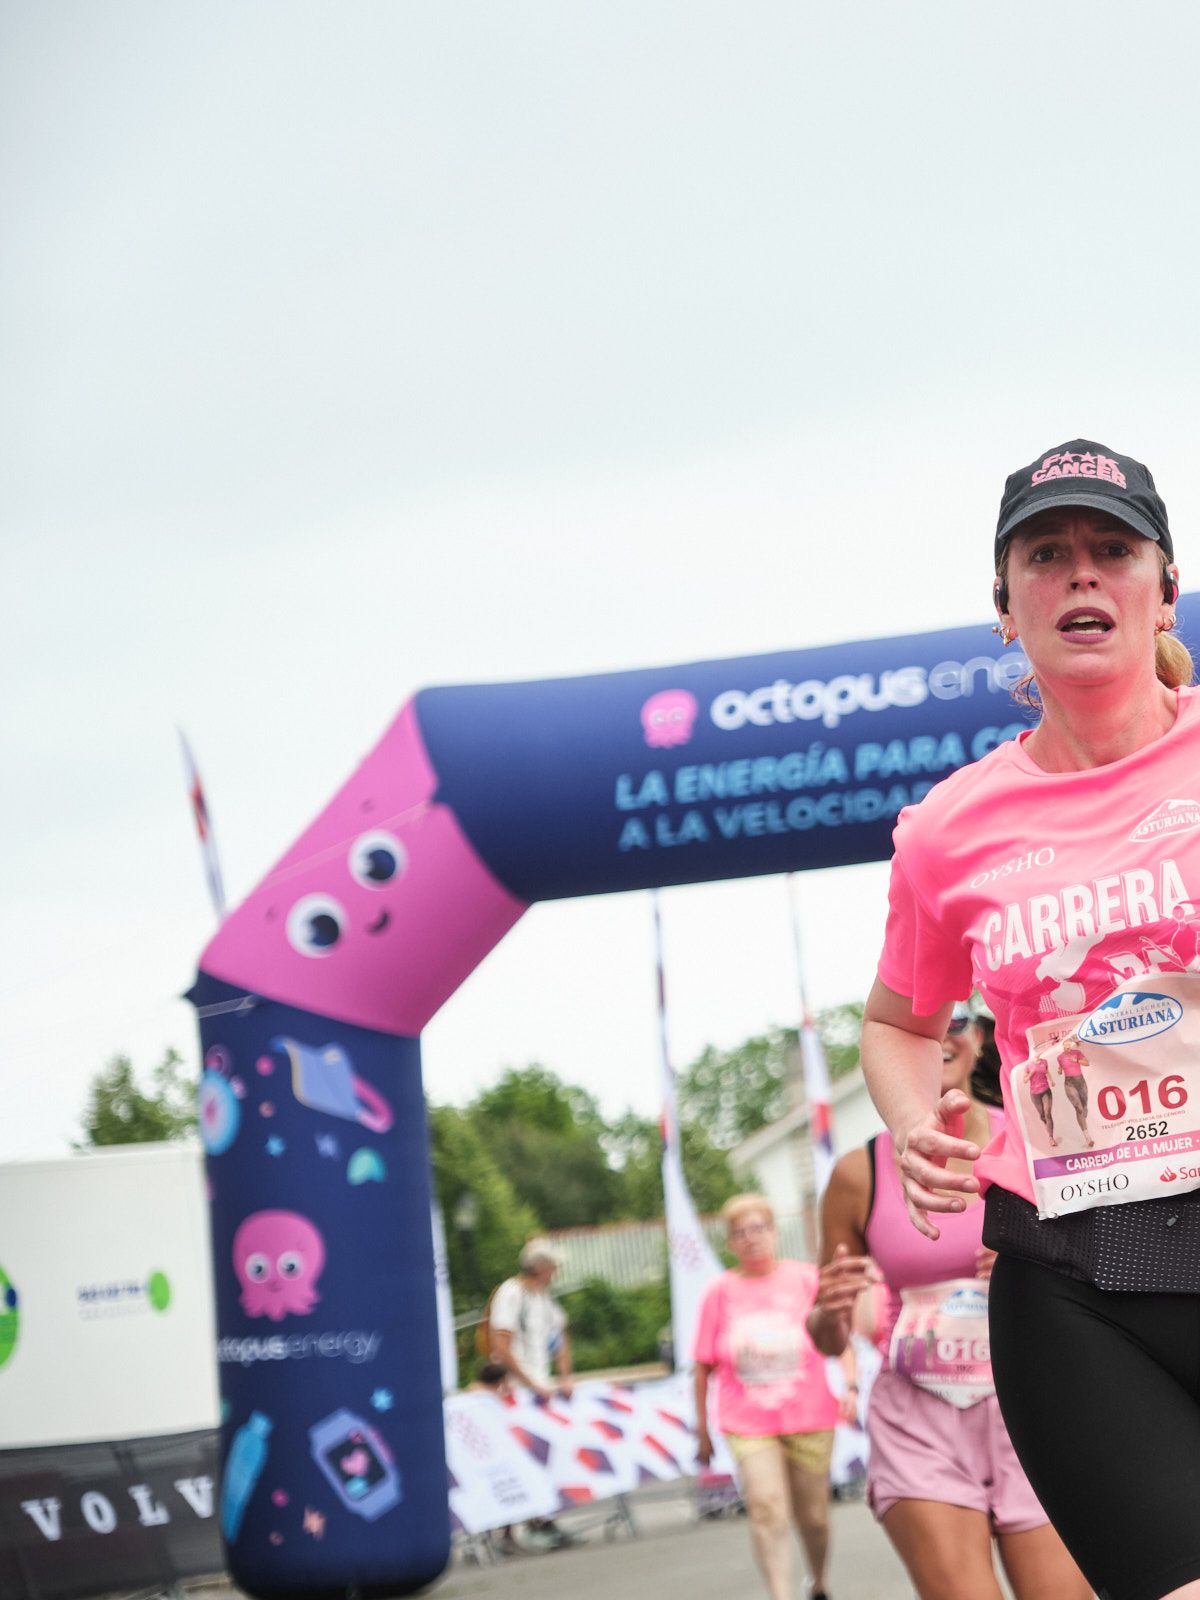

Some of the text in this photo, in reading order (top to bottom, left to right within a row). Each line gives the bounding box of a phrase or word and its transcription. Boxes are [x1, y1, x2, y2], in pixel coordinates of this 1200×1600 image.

[1031, 462, 1127, 486] CANCER
[615, 769, 669, 811] LA
[673, 740, 849, 804] ENERGÍA
[854, 731, 965, 780] PARA
[618, 816, 650, 852] A
[655, 809, 711, 847] LA
[970, 848, 1055, 888] OYSHO
[984, 859, 1195, 972] CARRERA
[1084, 1007, 1175, 1037] ASTURIANA
[1097, 1075, 1188, 1121] 016
[1125, 1120, 1169, 1141] 2652
[1066, 1152, 1114, 1171] CARRERA
[1116, 1145, 1132, 1160] DE
[1134, 1143, 1151, 1158] LA
[1153, 1136, 1194, 1154] MUJER
[1060, 1173, 1129, 1202] OYSHO
[936, 1338, 991, 1362] 016
[20, 1475, 215, 1542] VOLV
